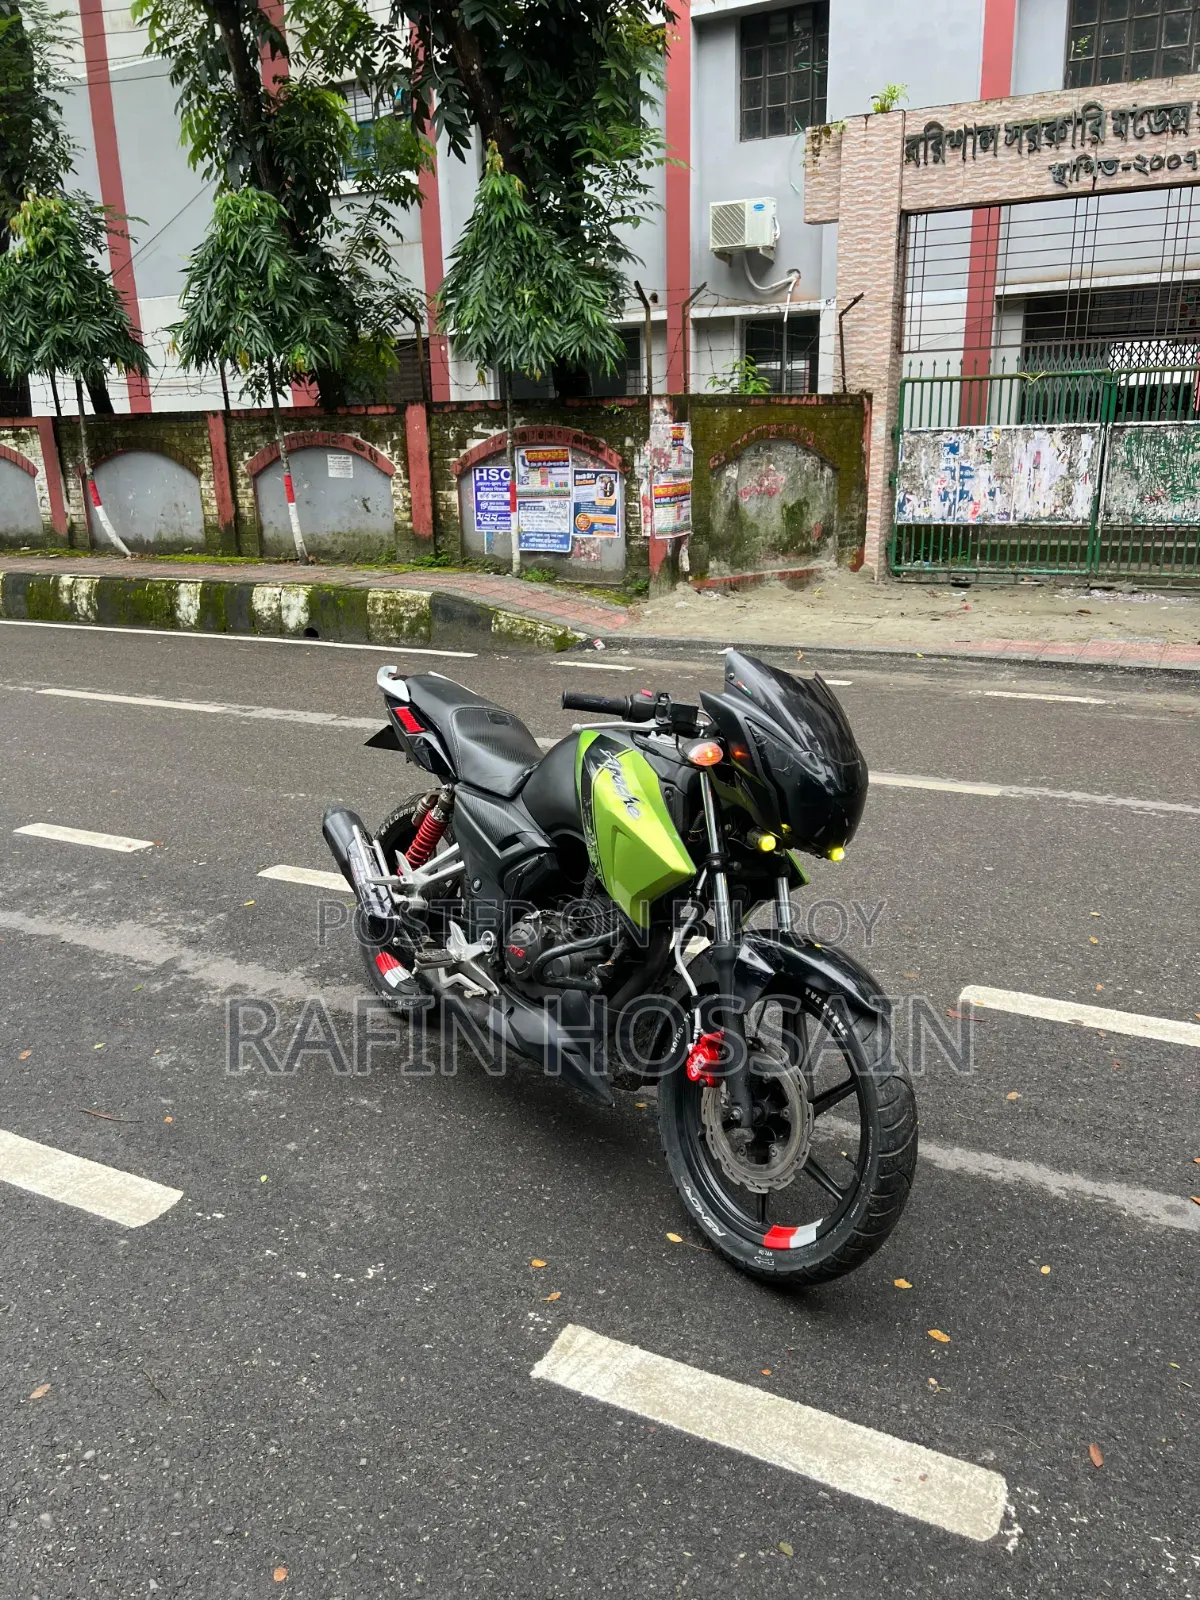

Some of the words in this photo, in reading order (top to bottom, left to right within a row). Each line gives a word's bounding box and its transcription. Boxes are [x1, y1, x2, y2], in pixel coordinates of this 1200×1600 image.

[904, 120, 1000, 167] বরিশাল
[1004, 100, 1107, 155] সরকারি
[1111, 101, 1193, 141] মডেল
[597, 748, 643, 821] Apache
[509, 943, 525, 958] TVS
